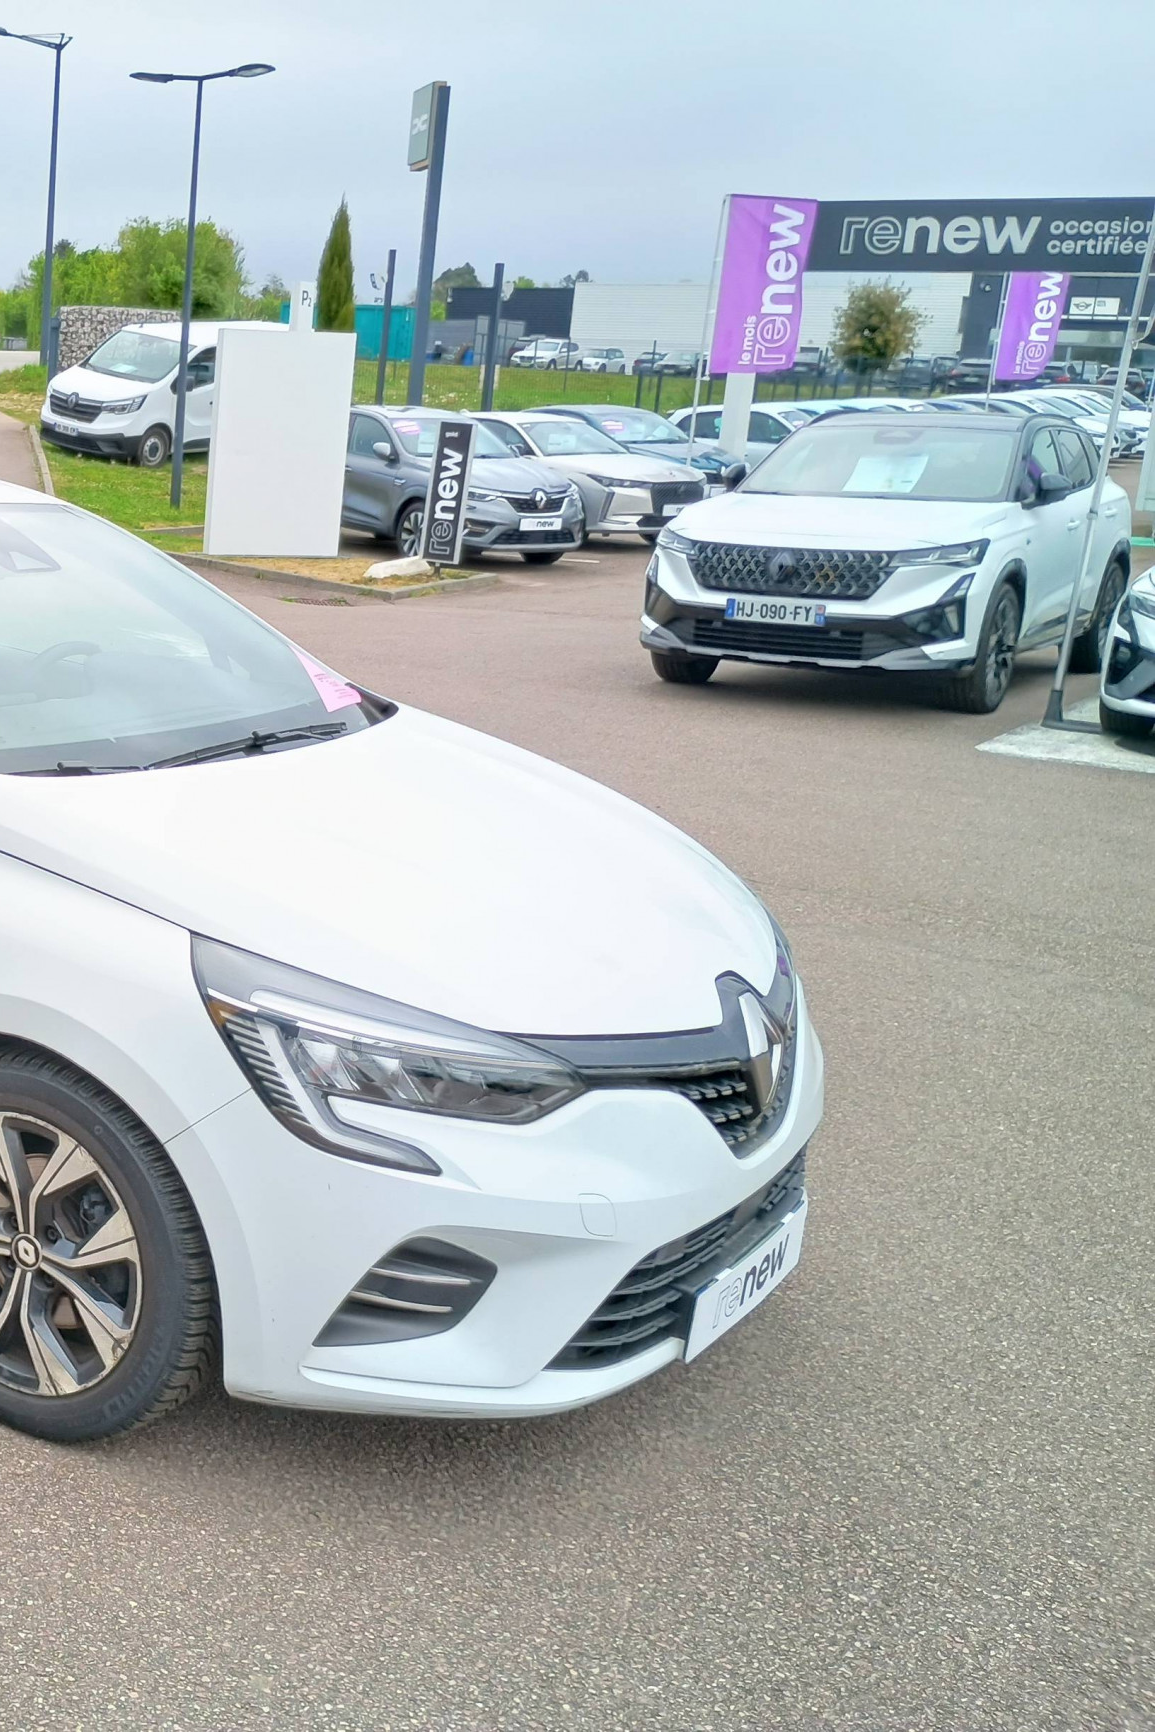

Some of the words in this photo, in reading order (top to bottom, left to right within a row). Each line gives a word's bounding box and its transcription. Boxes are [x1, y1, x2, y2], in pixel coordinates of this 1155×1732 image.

[839, 215, 1043, 255] renew
[1047, 236, 1155, 255] certifiée
[753, 203, 806, 366] renew
[743, 316, 757, 349] mois
[1021, 271, 1064, 375] renew
[738, 350, 752, 365] le
[429, 447, 464, 555] renew
[735, 601, 813, 622] HJ-090-FY
[711, 1233, 790, 1330] renew
